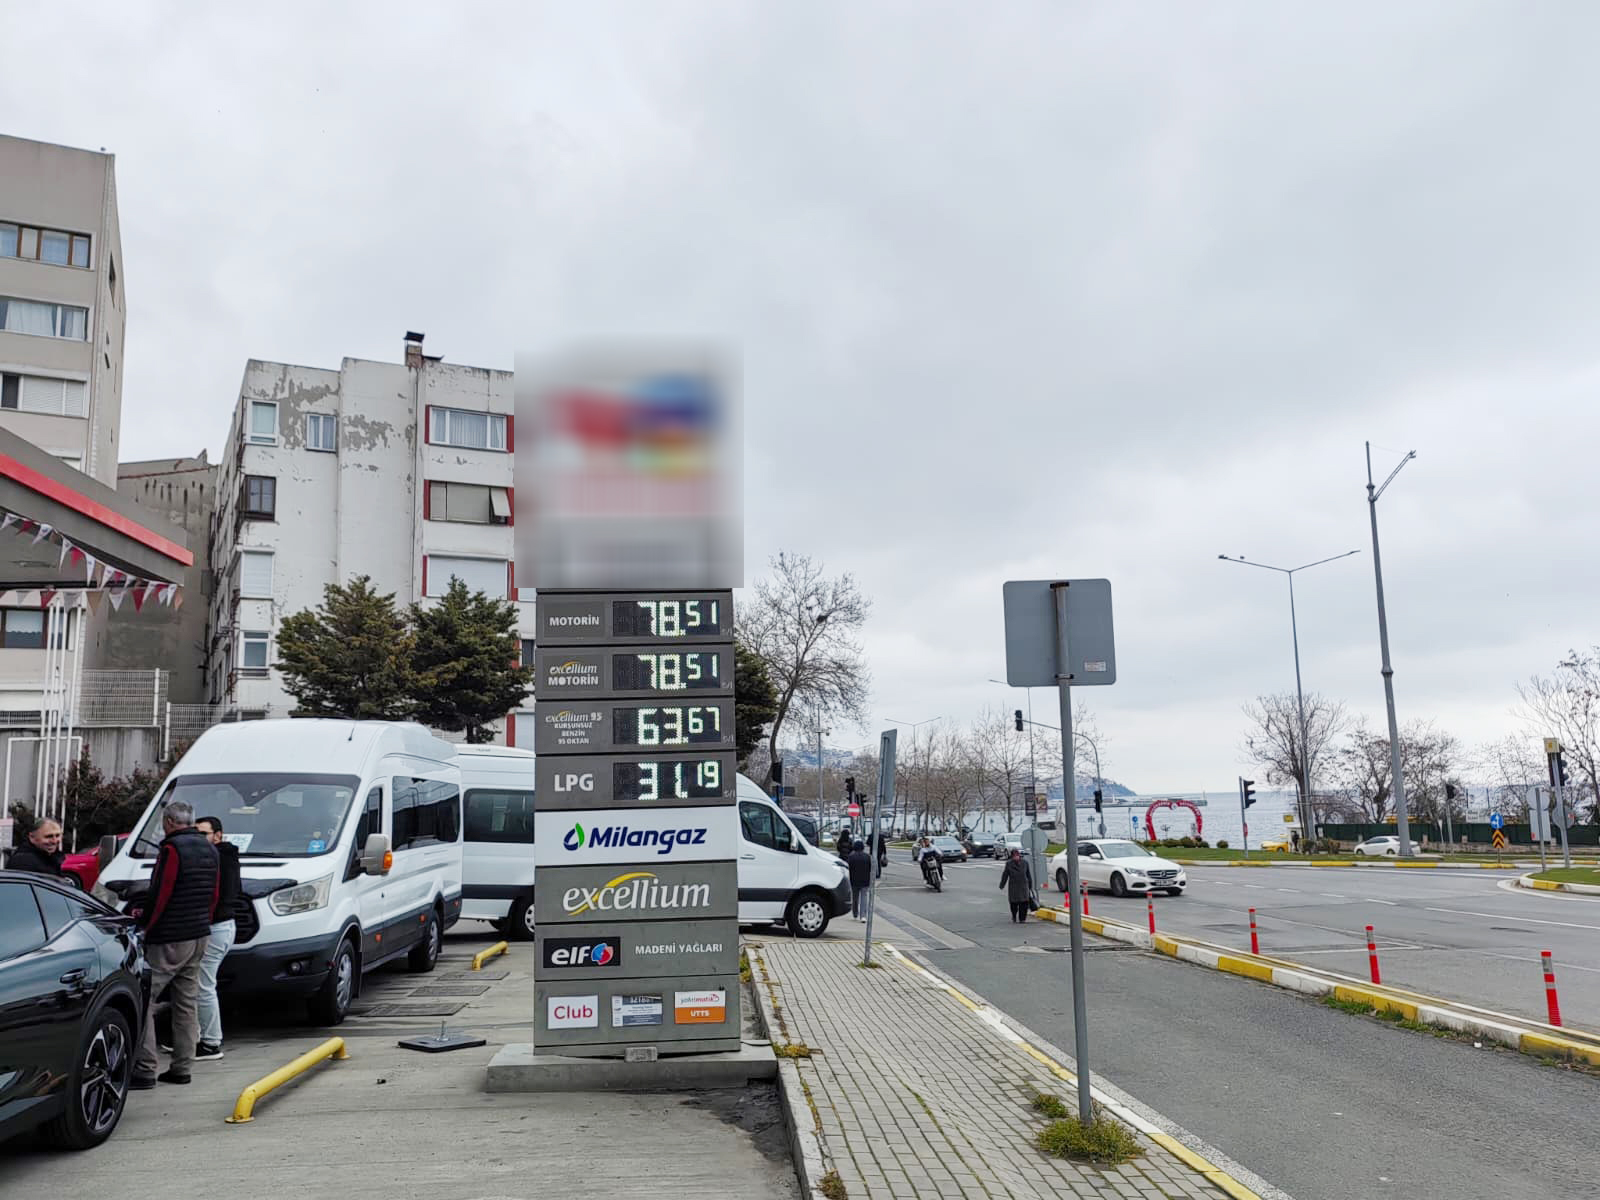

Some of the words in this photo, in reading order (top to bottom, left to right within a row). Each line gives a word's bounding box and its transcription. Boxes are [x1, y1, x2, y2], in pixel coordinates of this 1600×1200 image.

[549, 614, 600, 626] MOTORİN
[637, 600, 717, 637] 78.51
[549, 663, 597, 675] excellium
[637, 653, 718, 690] 78.51
[548, 674, 599, 686] MOTORİN
[545, 711, 588, 723] excellium
[638, 706, 720, 745] 63.67
[554, 773, 594, 792] LPG
[637, 761, 719, 800] 31.19
[588, 826, 708, 855] Milangaz
[562, 878, 711, 912] excellium
[551, 945, 591, 965] elf
[635, 942, 676, 955] MADENİ
[679, 940, 723, 953] YAĞLARI
[554, 1005, 594, 1020] Club
